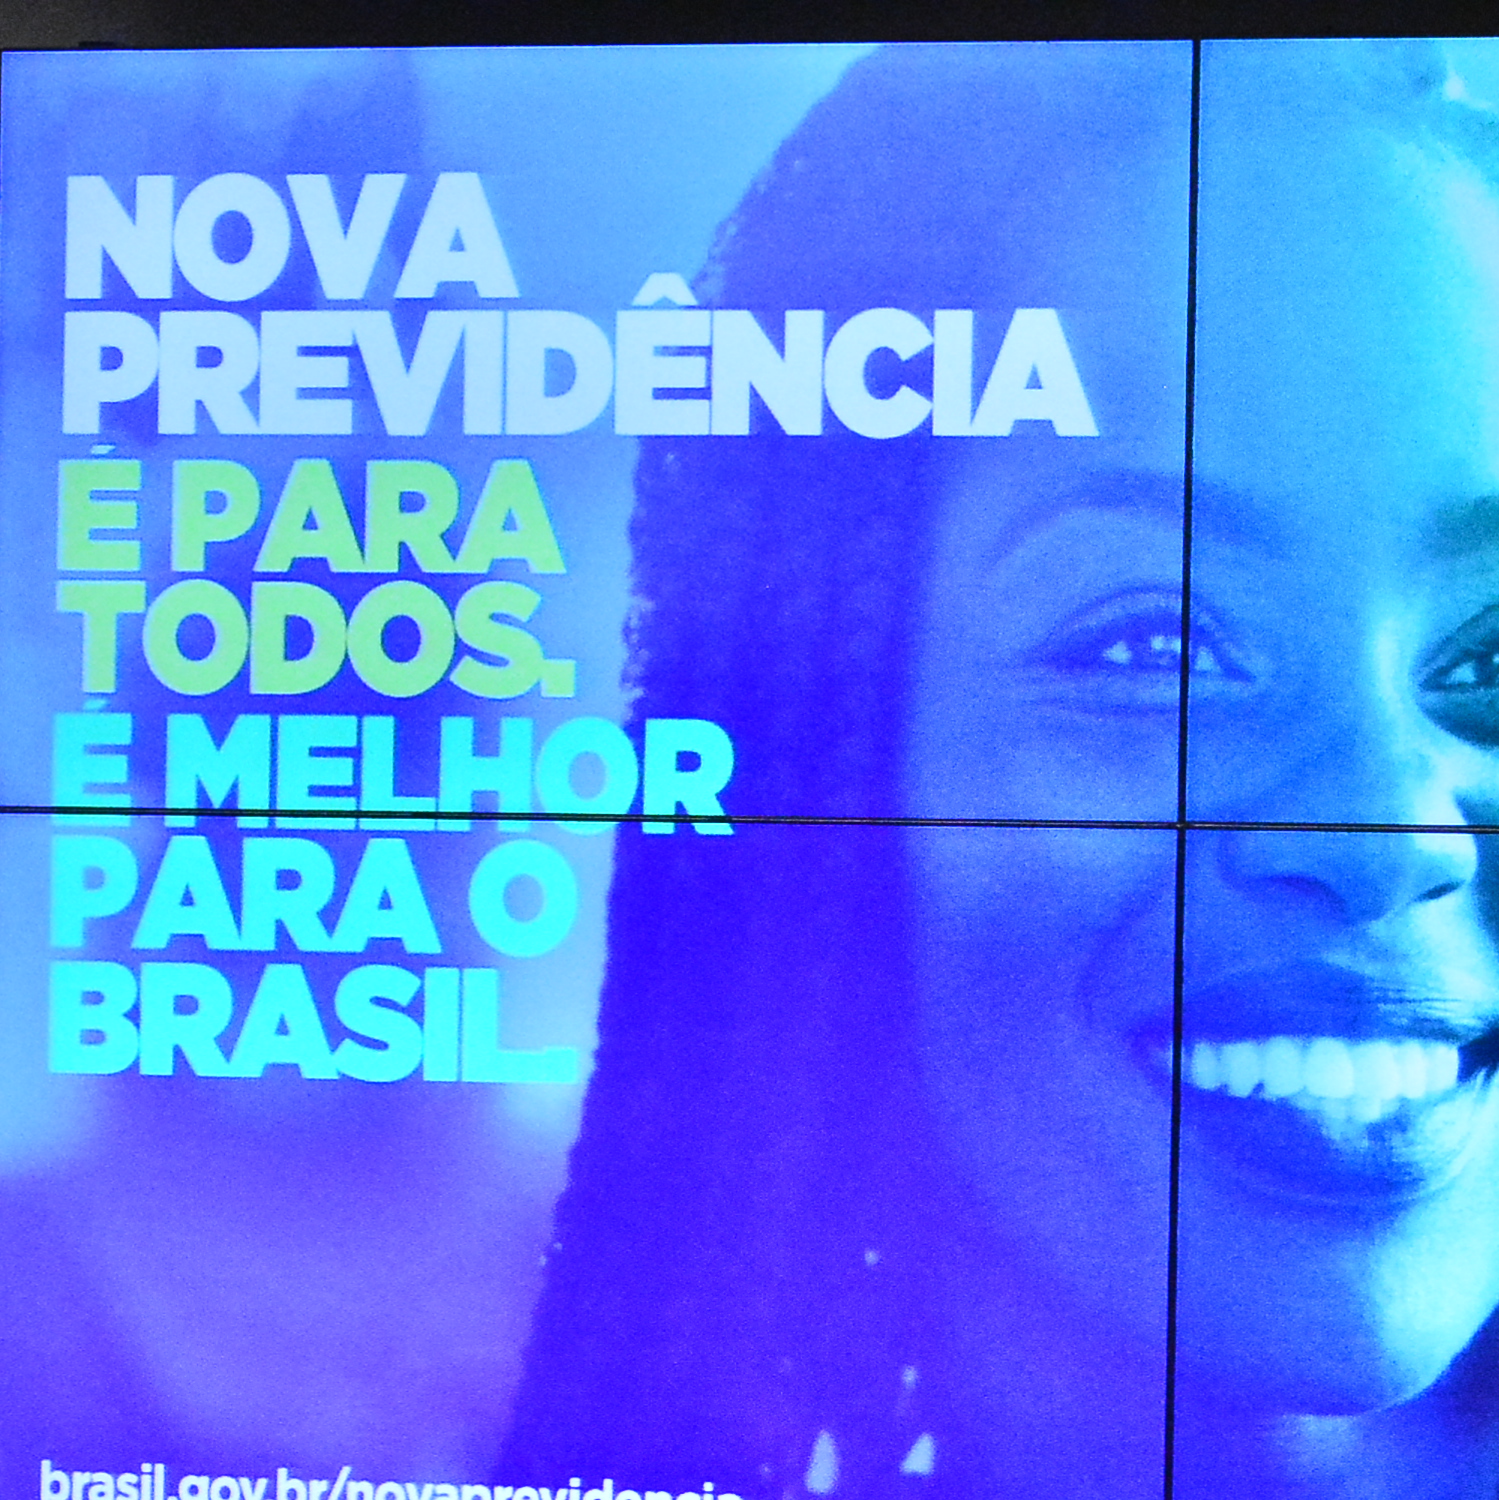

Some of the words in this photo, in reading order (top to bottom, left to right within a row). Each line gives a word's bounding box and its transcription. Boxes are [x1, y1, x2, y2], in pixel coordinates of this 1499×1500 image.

[64, 172, 520, 302] NOVA
[62, 272, 1099, 438] PREVIDÊNCIA
[56, 445, 142, 572] É
[170, 459, 567, 574] PARA
[56, 578, 576, 698] TODOS.
[51, 699, 133, 828] É
[164, 713, 734, 836] MELHOR
[49, 834, 443, 953] PARA
[468, 838, 579, 958] O
